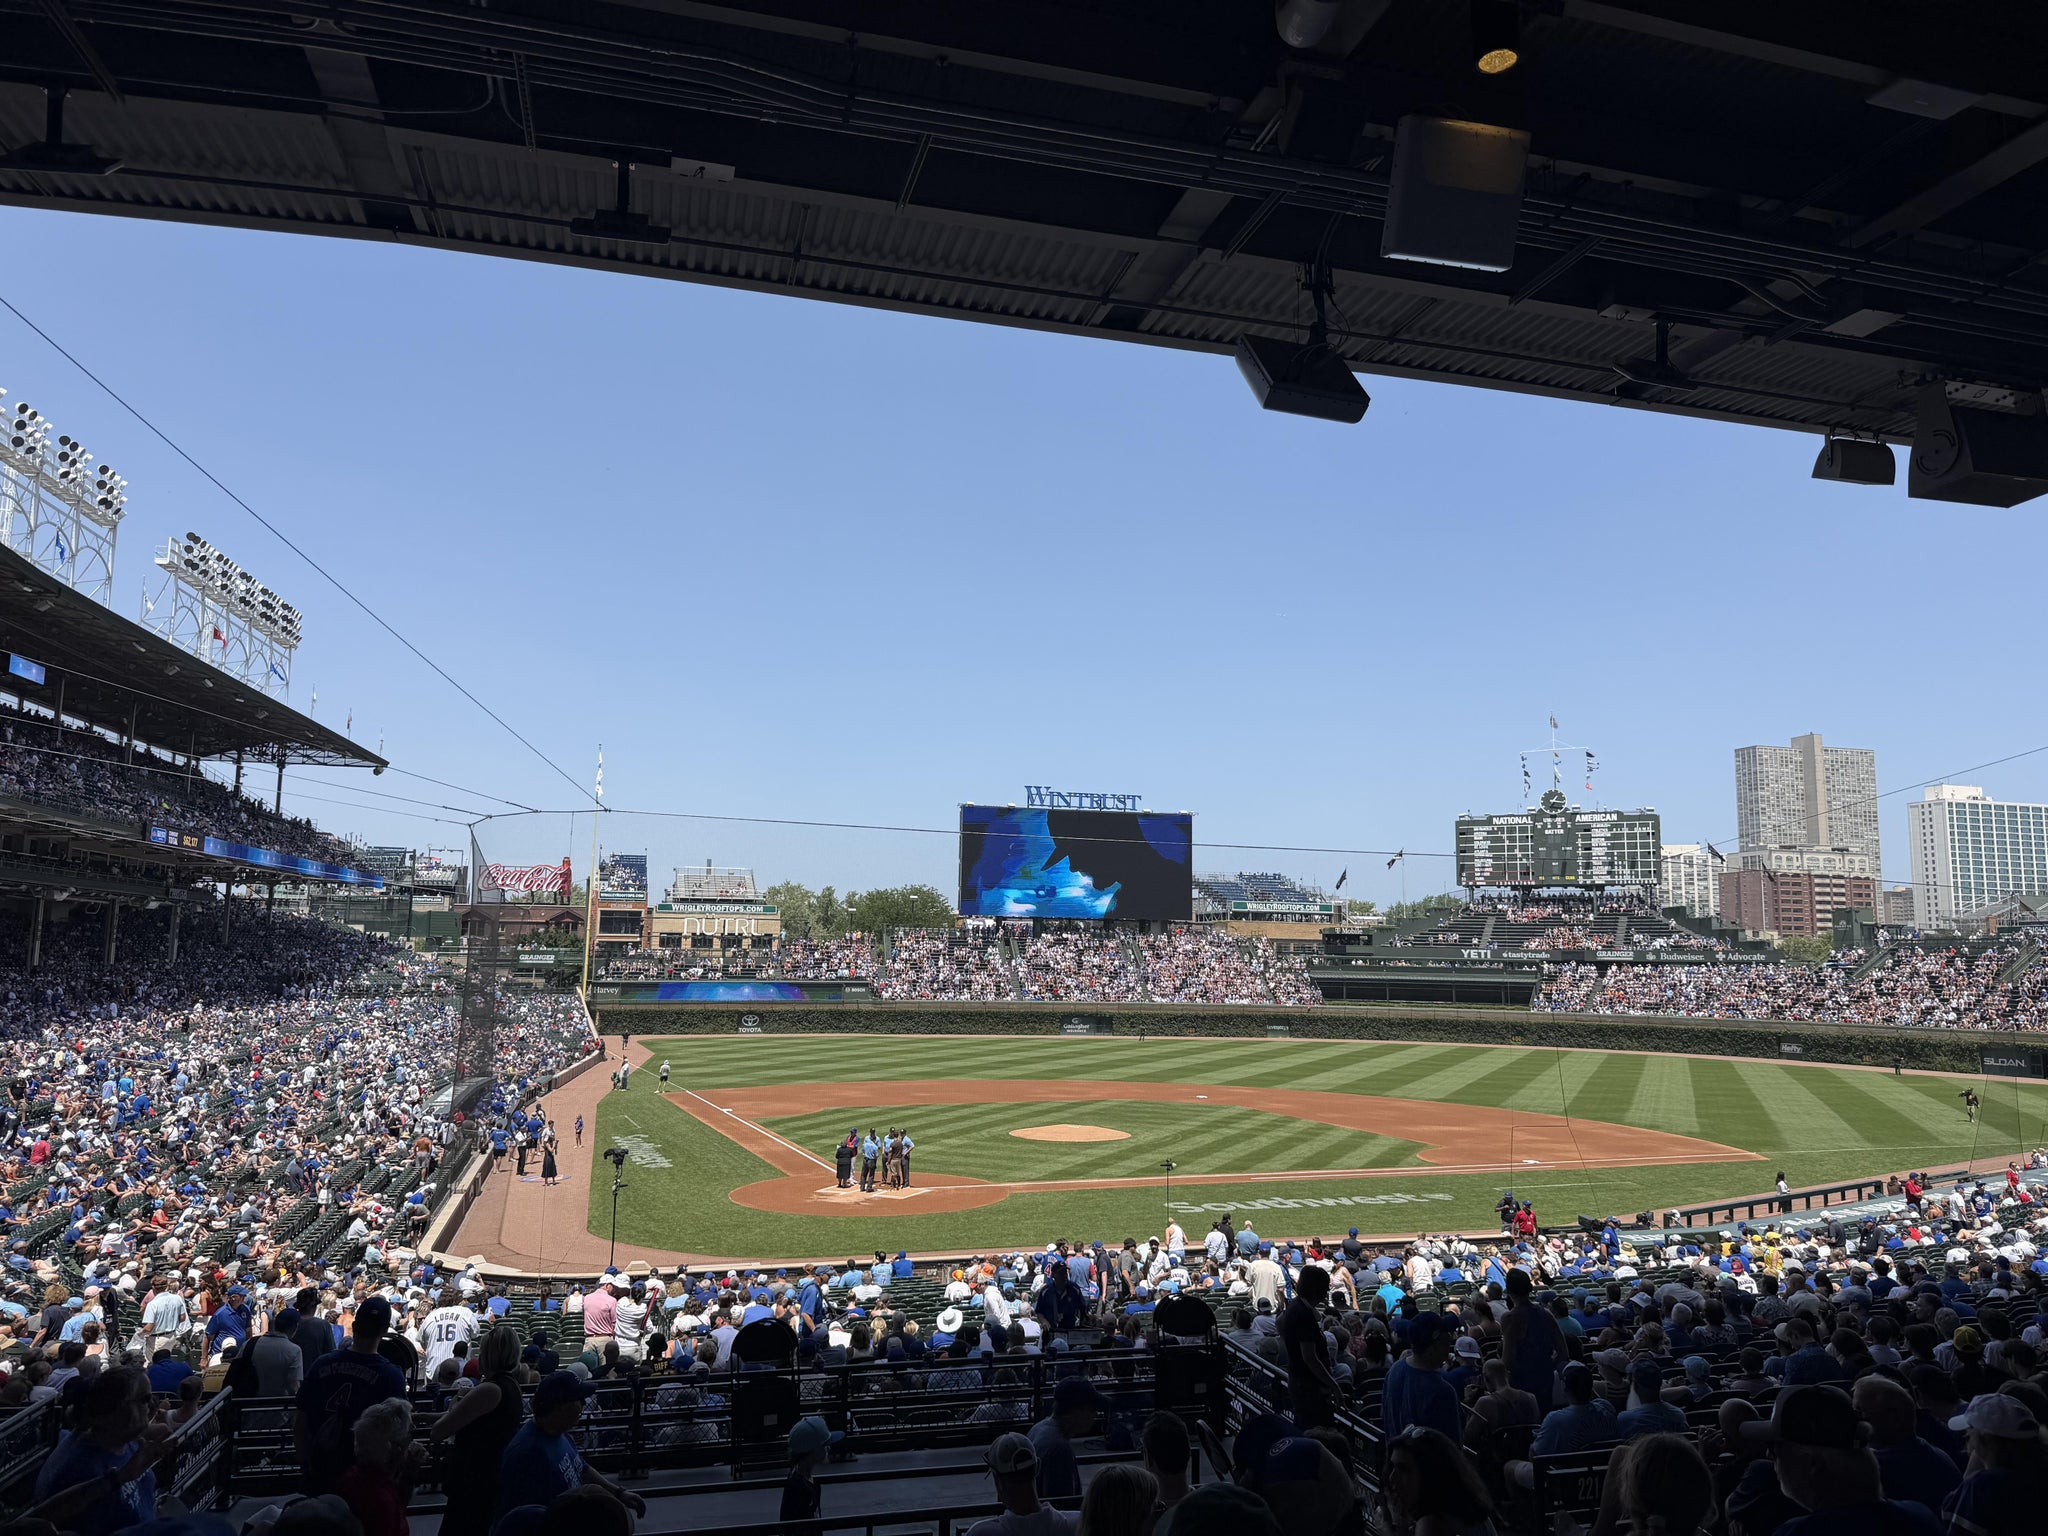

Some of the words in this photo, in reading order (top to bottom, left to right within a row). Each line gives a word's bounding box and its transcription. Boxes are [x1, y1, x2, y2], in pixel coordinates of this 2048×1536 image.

[1024, 786, 1142, 811] WINTRUST
[1492, 816, 1533, 825] NATIONAL
[1575, 813, 1618, 822] AMERICAN
[478, 864, 568, 892] Coca-Cola
[672, 904, 764, 913] WRIGLEYROOFTOPS.COM
[1246, 902, 1320, 912] WRIGLEYROOFTOPS.COM
[1461, 949, 1491, 959] YETI
[1508, 951, 1551, 960] tastytrade
[1727, 952, 1766, 961] Advocate
[593, 986, 619, 995] Harvey
[1983, 1057, 2025, 1068] SLOAN
[1164, 1192, 1416, 1213] Southwest
[434, 1312, 461, 1323] LOGAN
[436, 1323, 457, 1343] 16
[1578, 1476, 1599, 1500] 221
